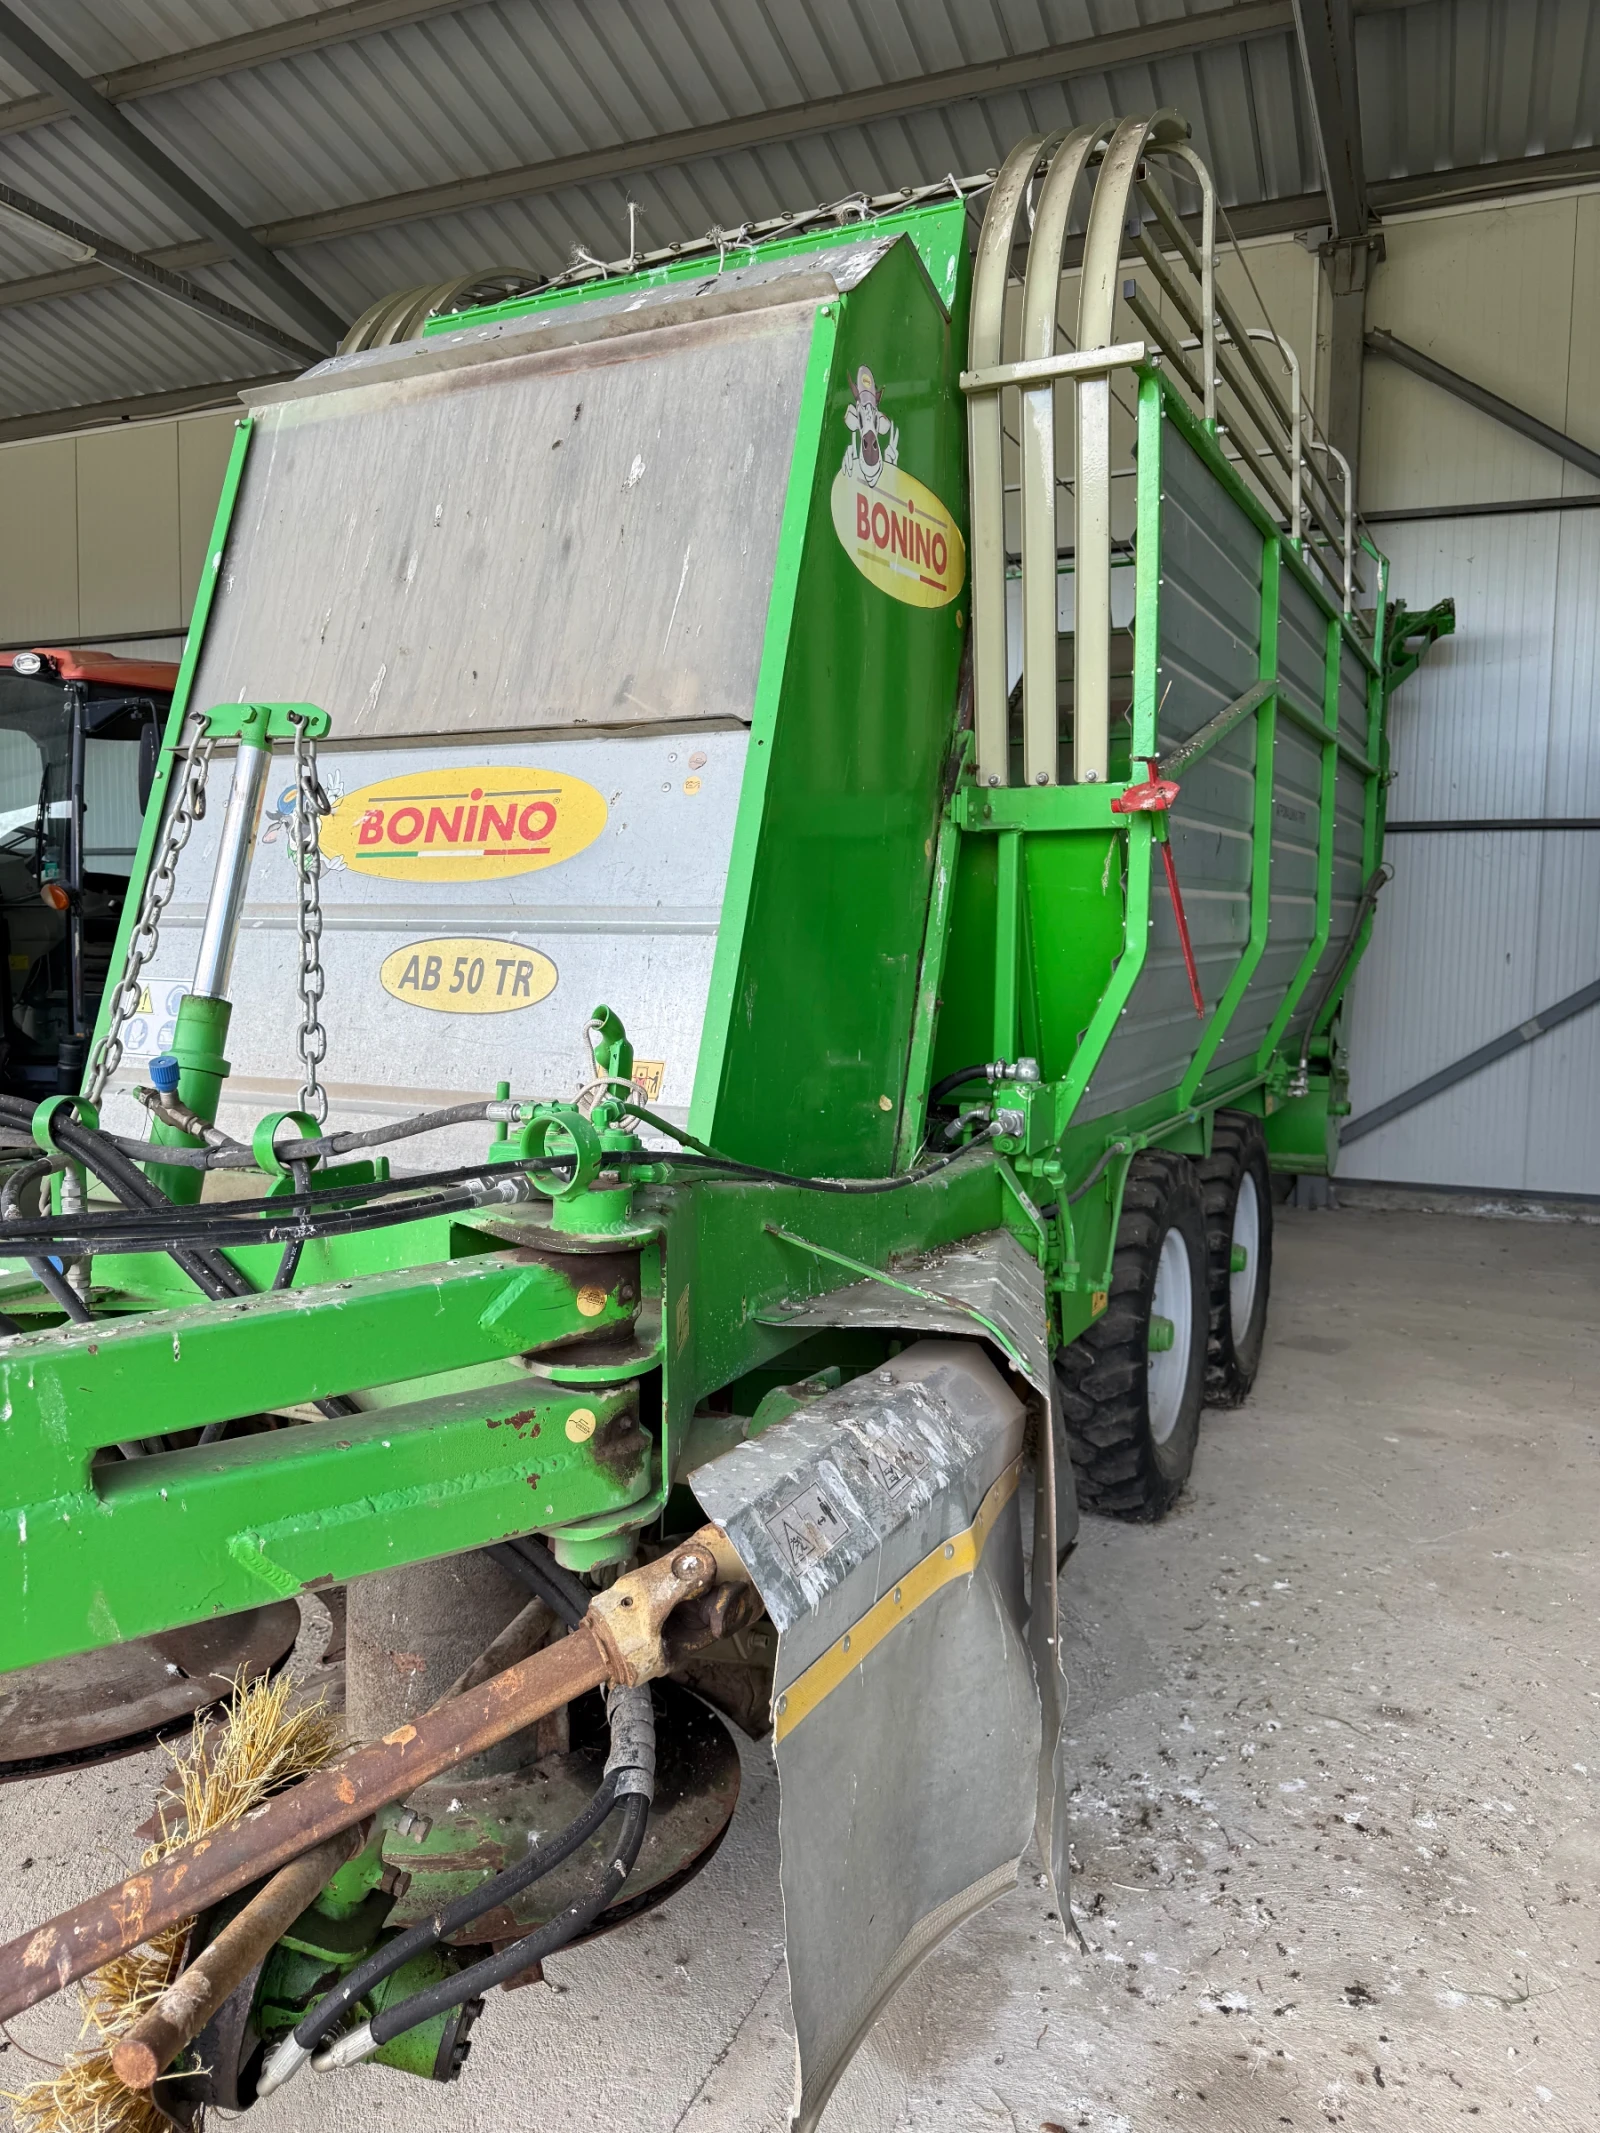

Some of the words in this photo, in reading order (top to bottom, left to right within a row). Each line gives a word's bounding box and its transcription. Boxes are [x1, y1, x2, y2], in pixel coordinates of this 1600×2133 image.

[857, 493, 947, 576] BONINO
[356, 788, 557, 845] BONINO
[397, 955, 443, 991] AB
[449, 957, 485, 994] 50
[495, 959, 534, 997] TR
